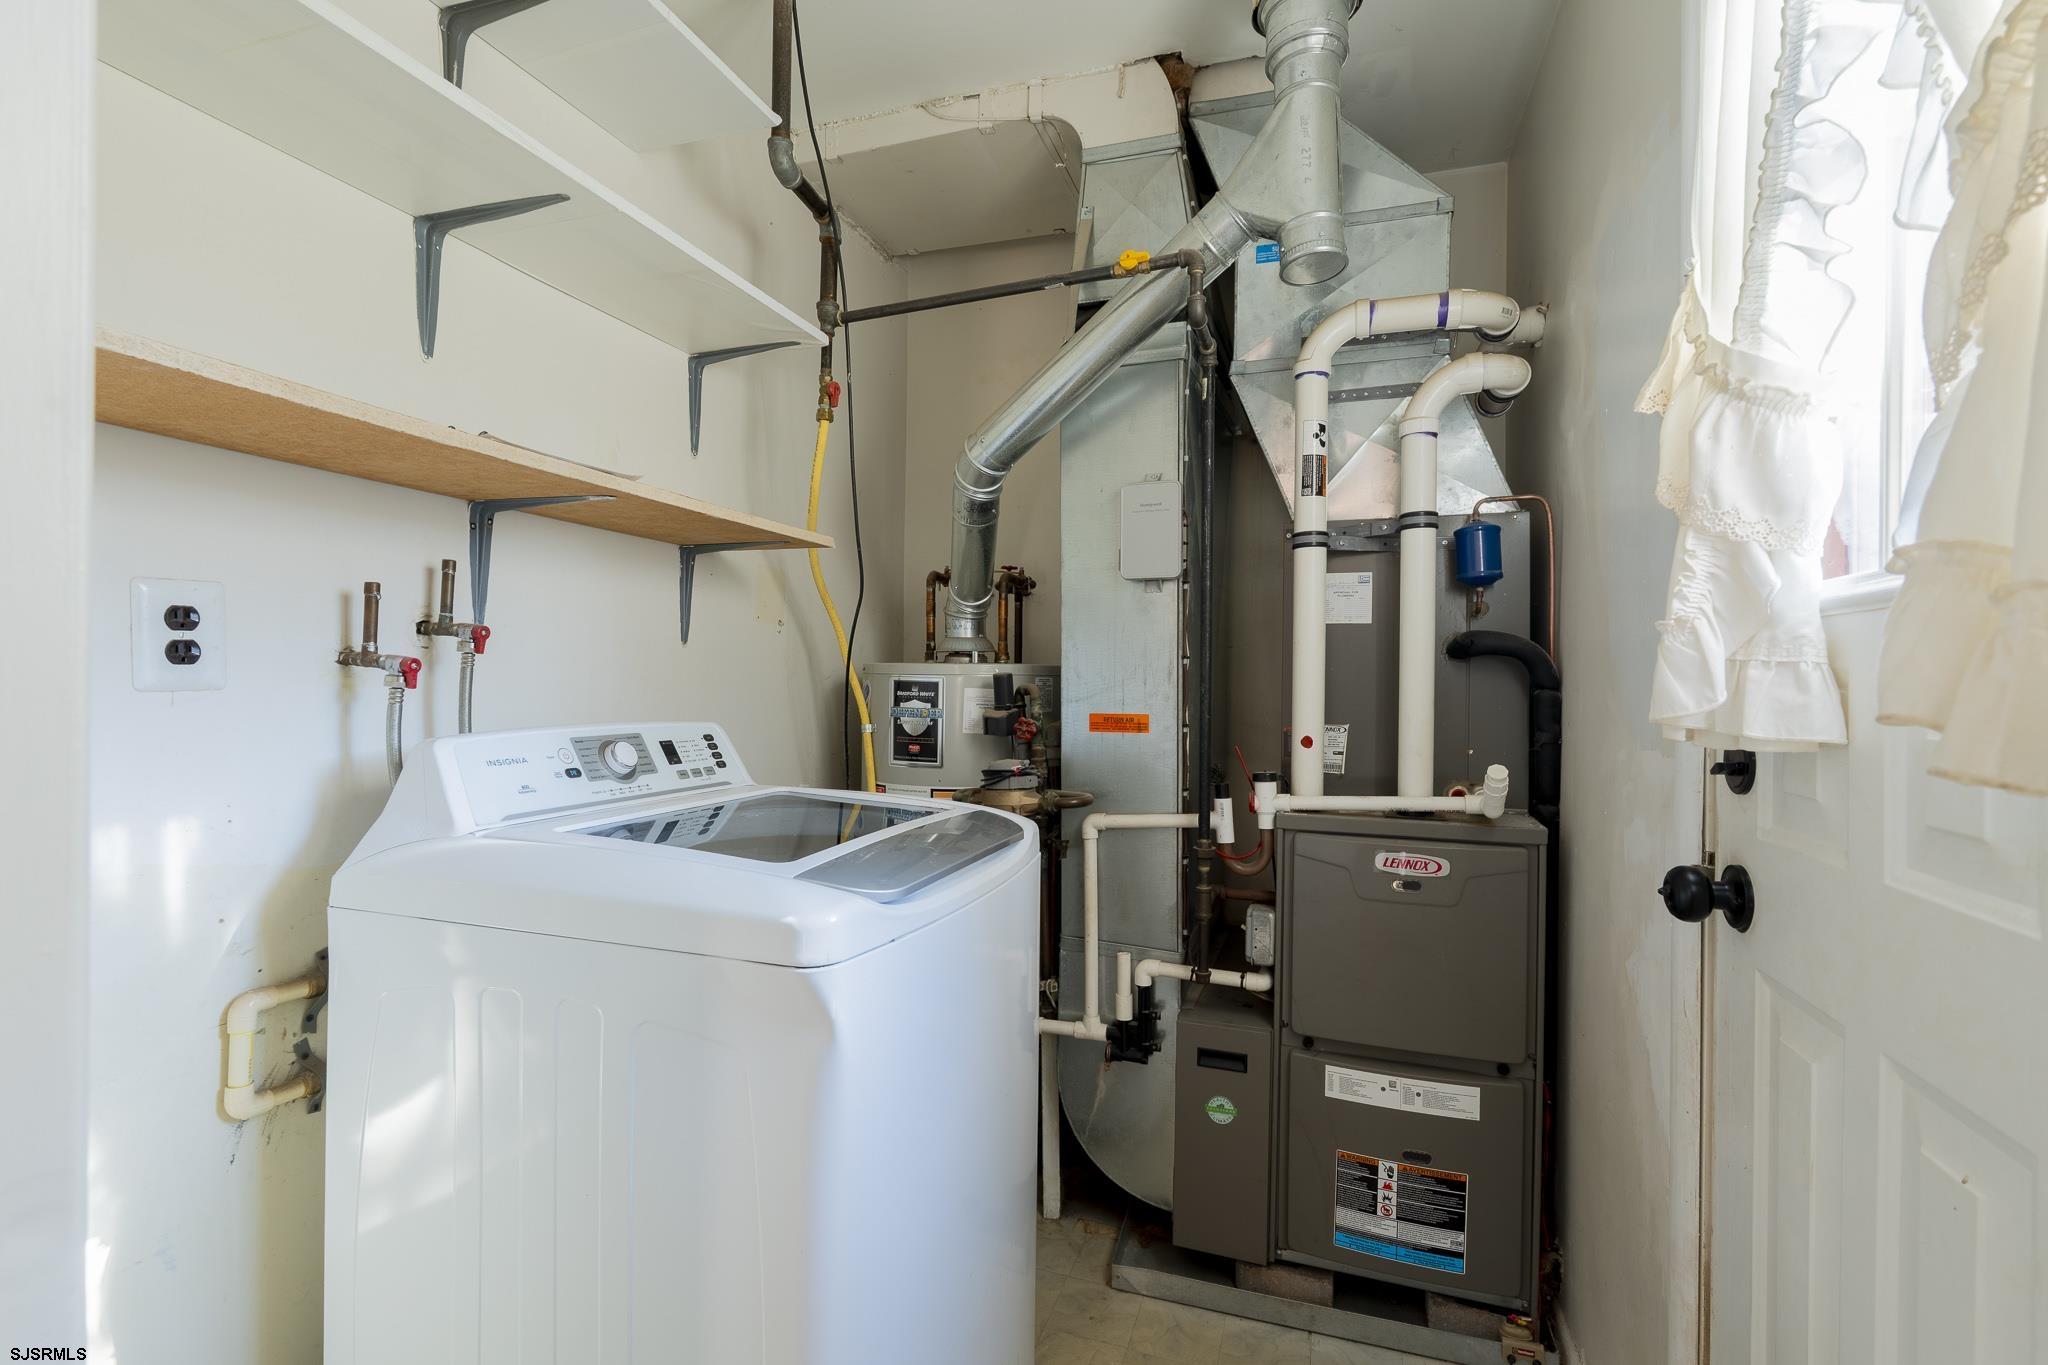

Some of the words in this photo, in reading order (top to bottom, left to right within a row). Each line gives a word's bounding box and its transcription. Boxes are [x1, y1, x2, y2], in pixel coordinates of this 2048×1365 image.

[891, 707, 943, 719] DEFENDER
[485, 757, 529, 767] INSIGNIA
[1383, 857, 1431, 871] LENNOX
